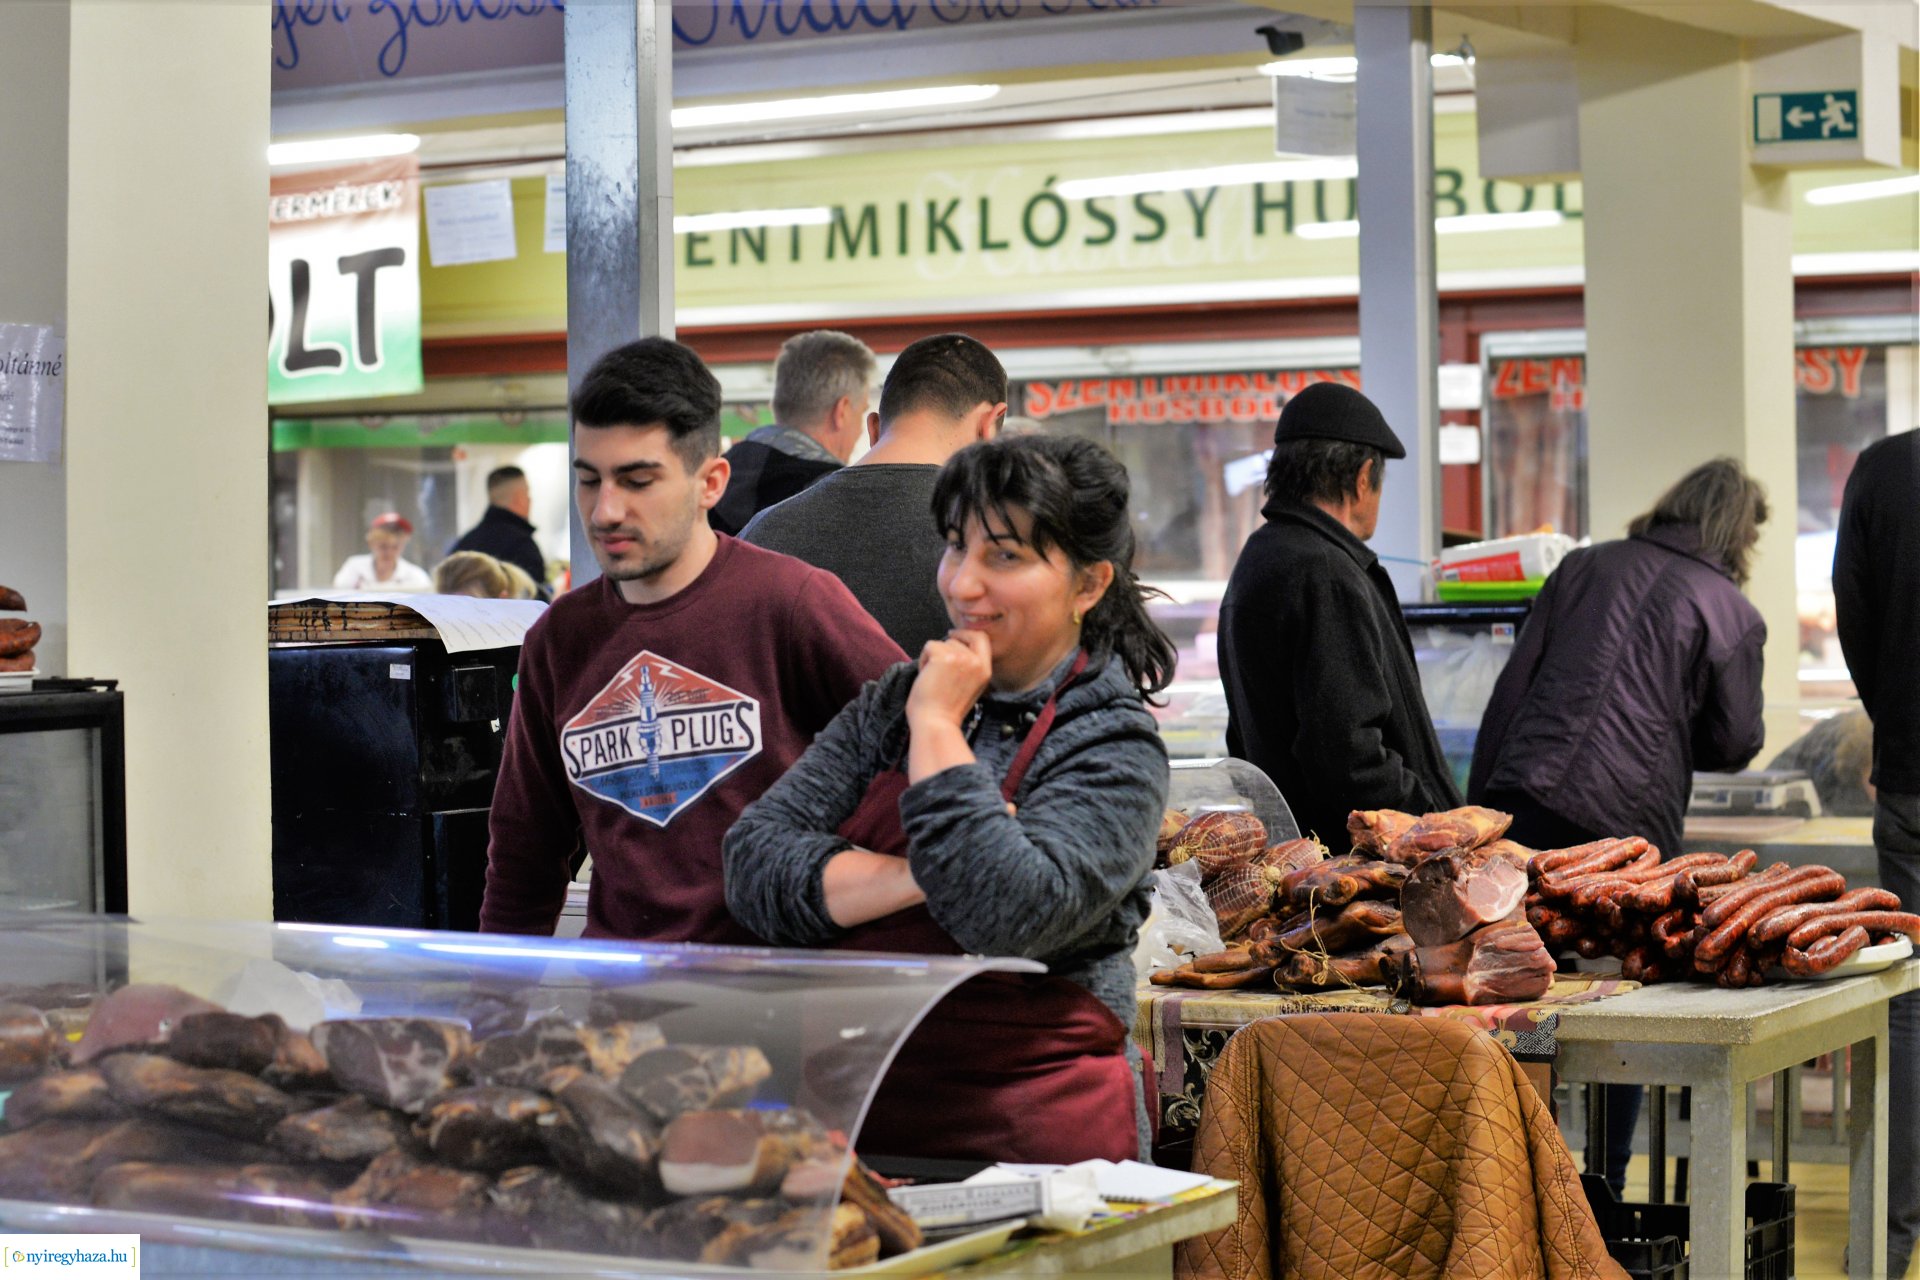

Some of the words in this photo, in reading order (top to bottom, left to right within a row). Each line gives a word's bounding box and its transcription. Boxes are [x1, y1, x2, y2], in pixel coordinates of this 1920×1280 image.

[269, 247, 406, 373] LT
[563, 727, 633, 780] SPARK
[671, 701, 755, 752] PLUGS
